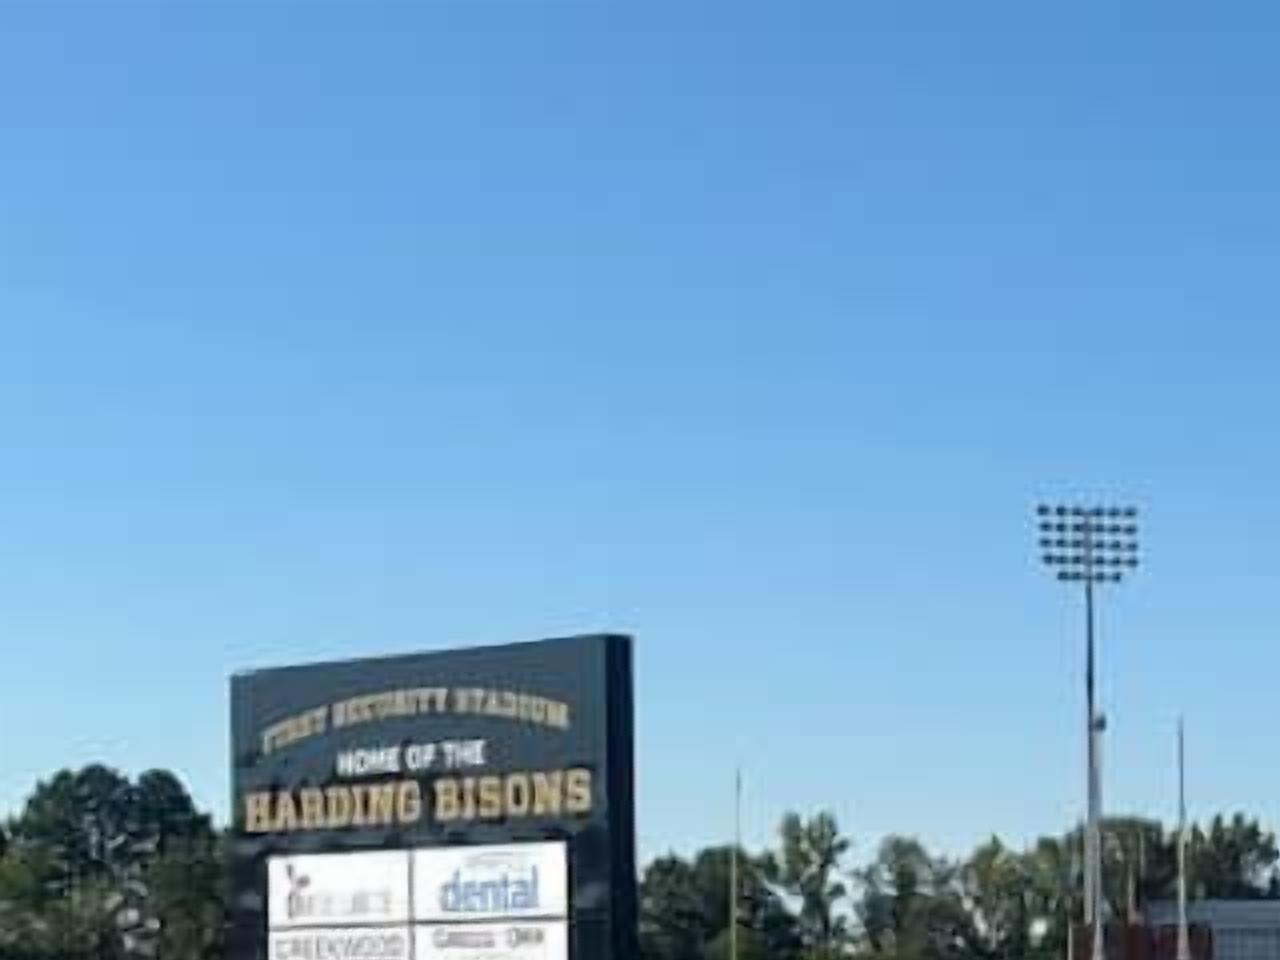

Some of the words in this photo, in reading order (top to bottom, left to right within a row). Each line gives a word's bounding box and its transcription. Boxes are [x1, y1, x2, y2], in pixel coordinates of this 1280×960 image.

[451, 687, 570, 732] STADIUM
[336, 745, 401, 778] HOME
[404, 743, 437, 771] OF
[442, 739, 487, 767] THE
[244, 778, 422, 834] HARDING
[433, 767, 593, 823] BISONS
[439, 863, 540, 913] dental
